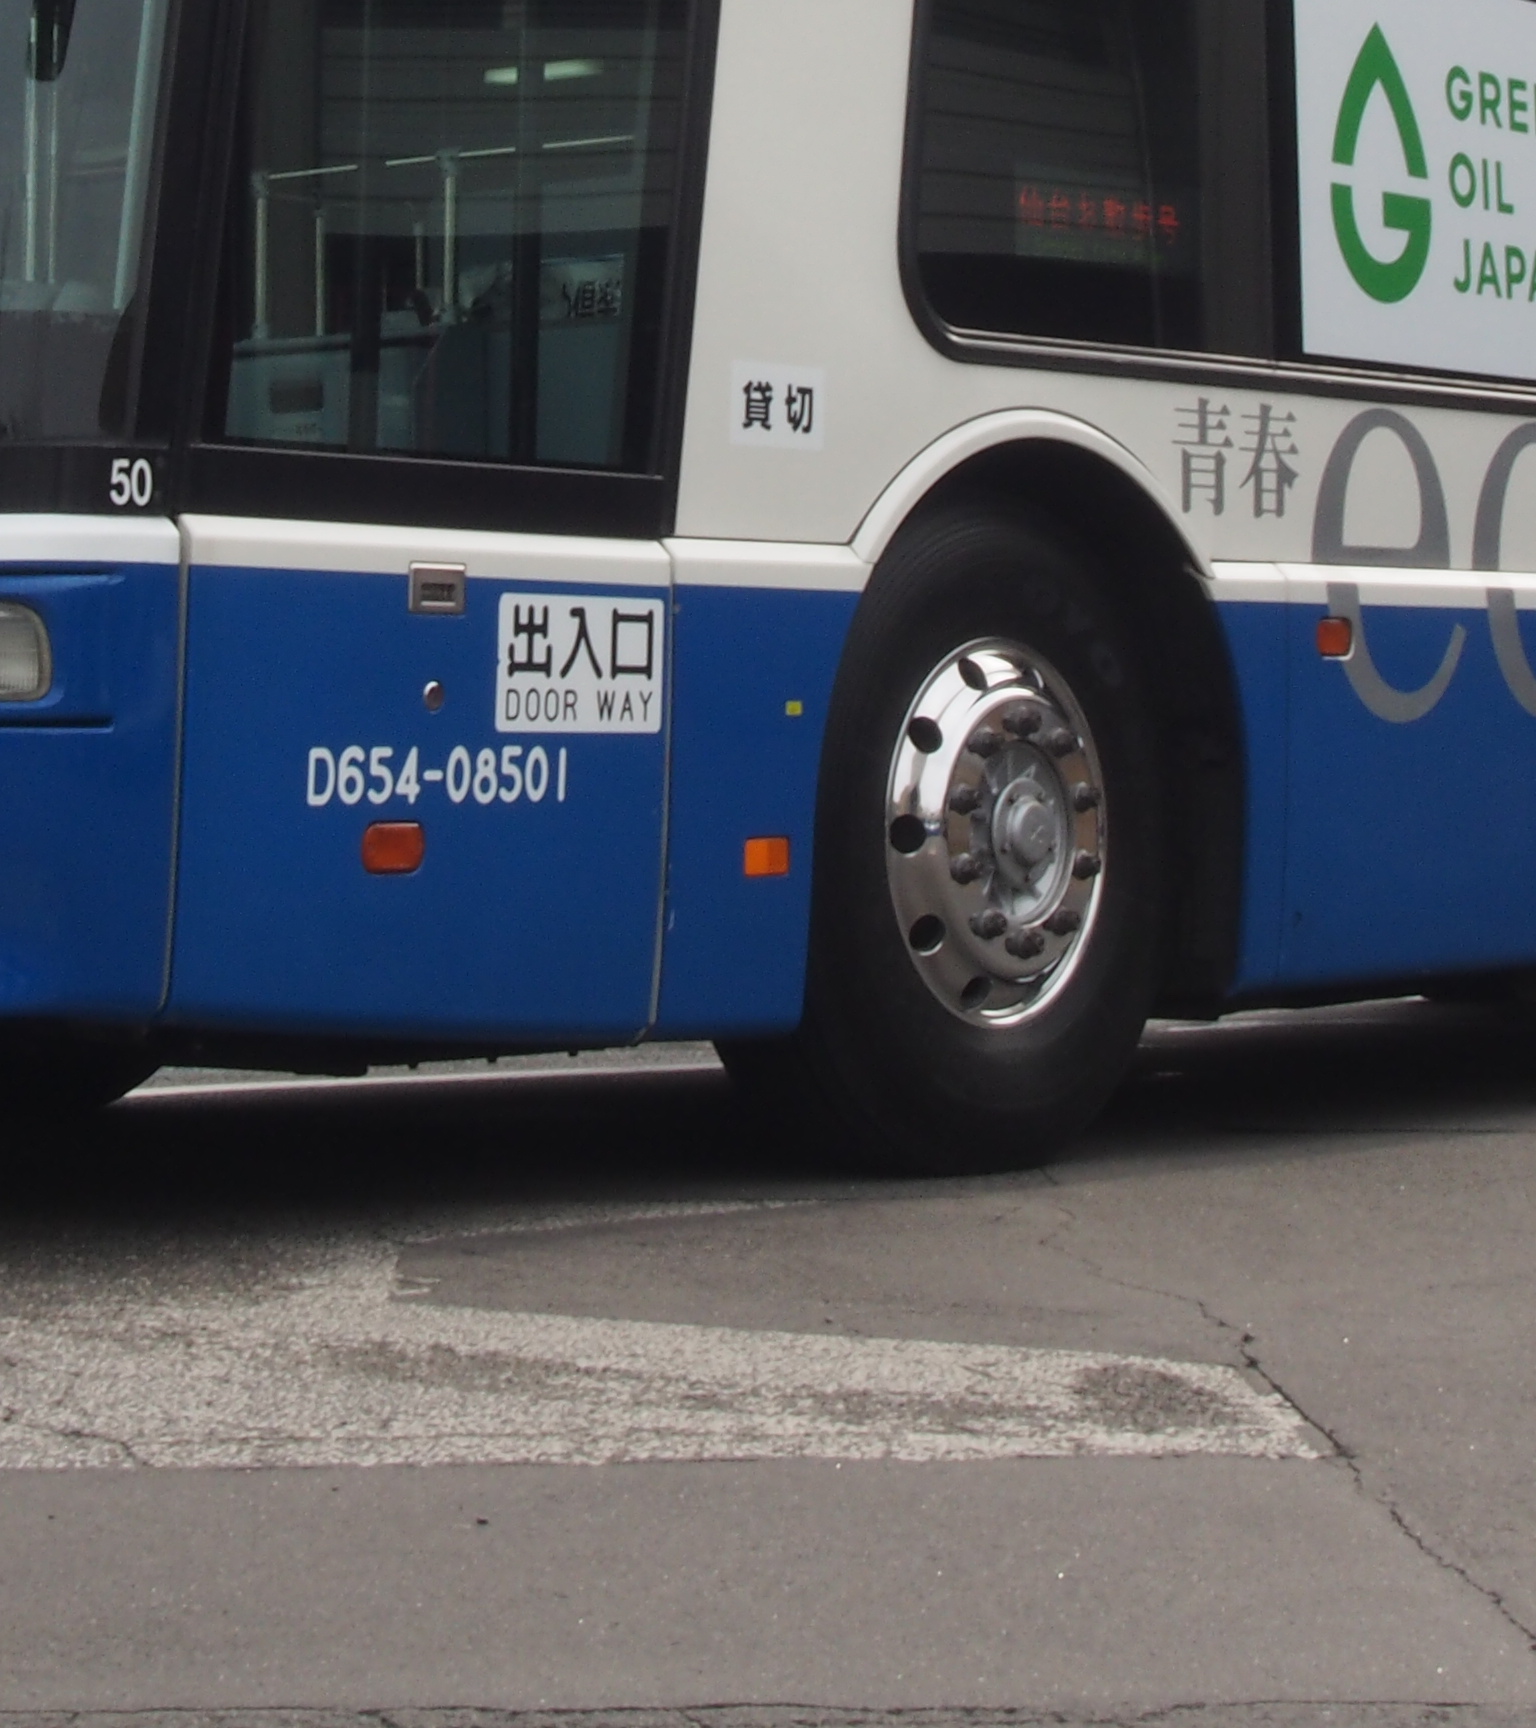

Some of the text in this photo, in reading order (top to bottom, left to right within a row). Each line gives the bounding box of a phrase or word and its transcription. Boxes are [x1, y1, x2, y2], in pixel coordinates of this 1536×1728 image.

[1449, 152, 1515, 215] OIL
[741, 381, 815, 434] 貸切
[109, 457, 153, 506] 50
[1172, 397, 1300, 521] 青春
[507, 603, 655, 681] 出入口
[505, 688, 654, 722] DOOR WAY
[305, 745, 567, 806] D654-08501
